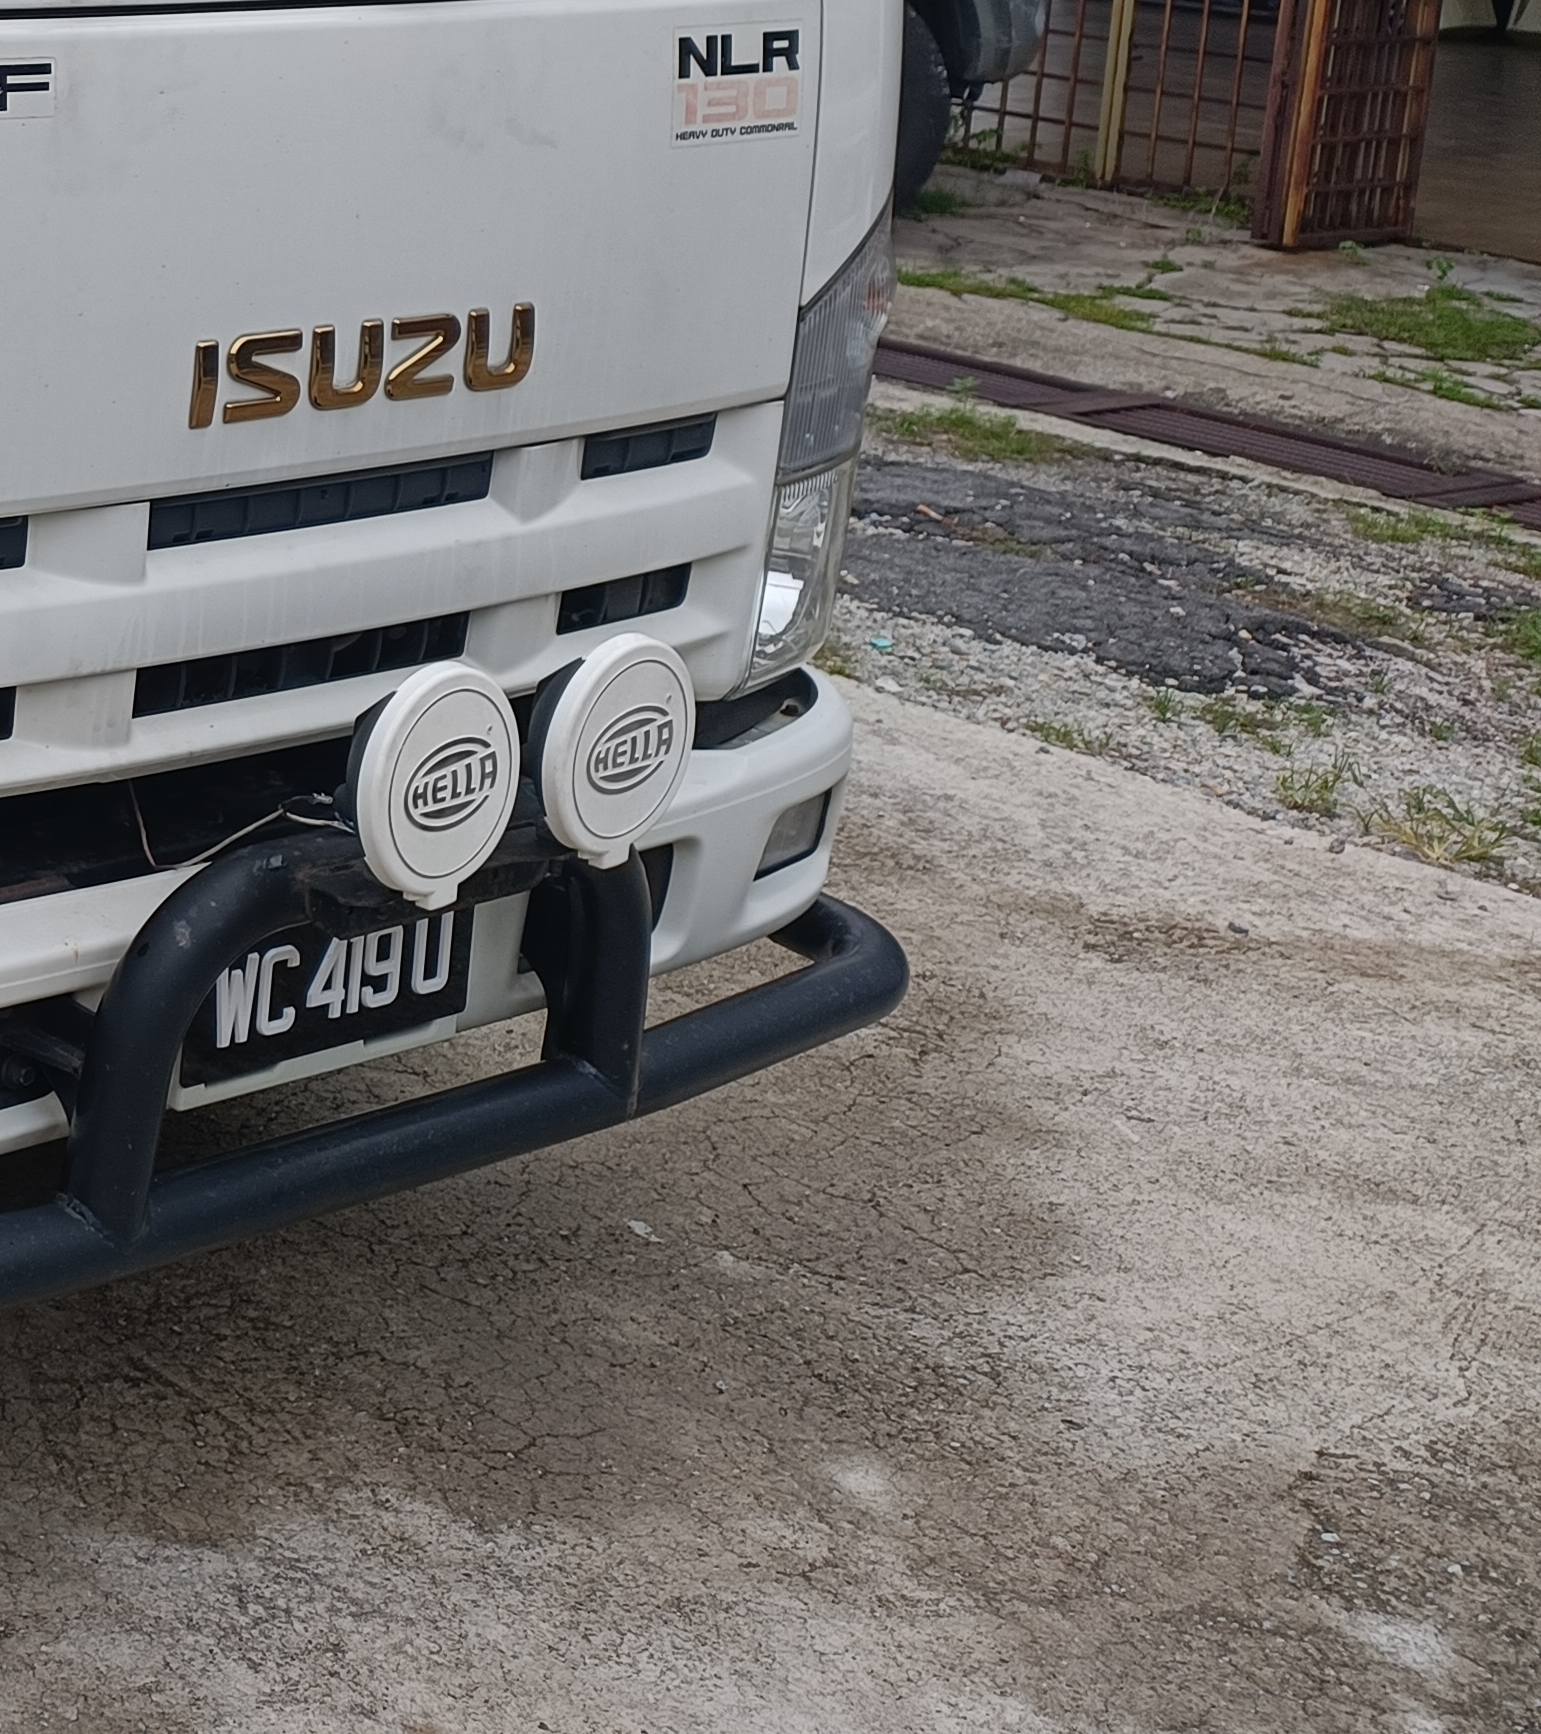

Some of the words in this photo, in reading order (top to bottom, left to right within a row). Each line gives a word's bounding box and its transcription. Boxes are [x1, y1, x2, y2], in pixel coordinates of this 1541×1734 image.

[678, 29, 801, 79] NLR
[677, 77, 799, 126] 130
[675, 129, 708, 142] HEAVY
[710, 127, 737, 139] DUTY
[739, 121, 798, 137] COMMONRAIL
[189, 302, 536, 430] ISUZU
[593, 718, 675, 774] HELLA
[412, 750, 499, 809] HELLA
[216, 944, 301, 1049] WC
[306, 925, 404, 1019] 419
[411, 911, 455, 995] U
